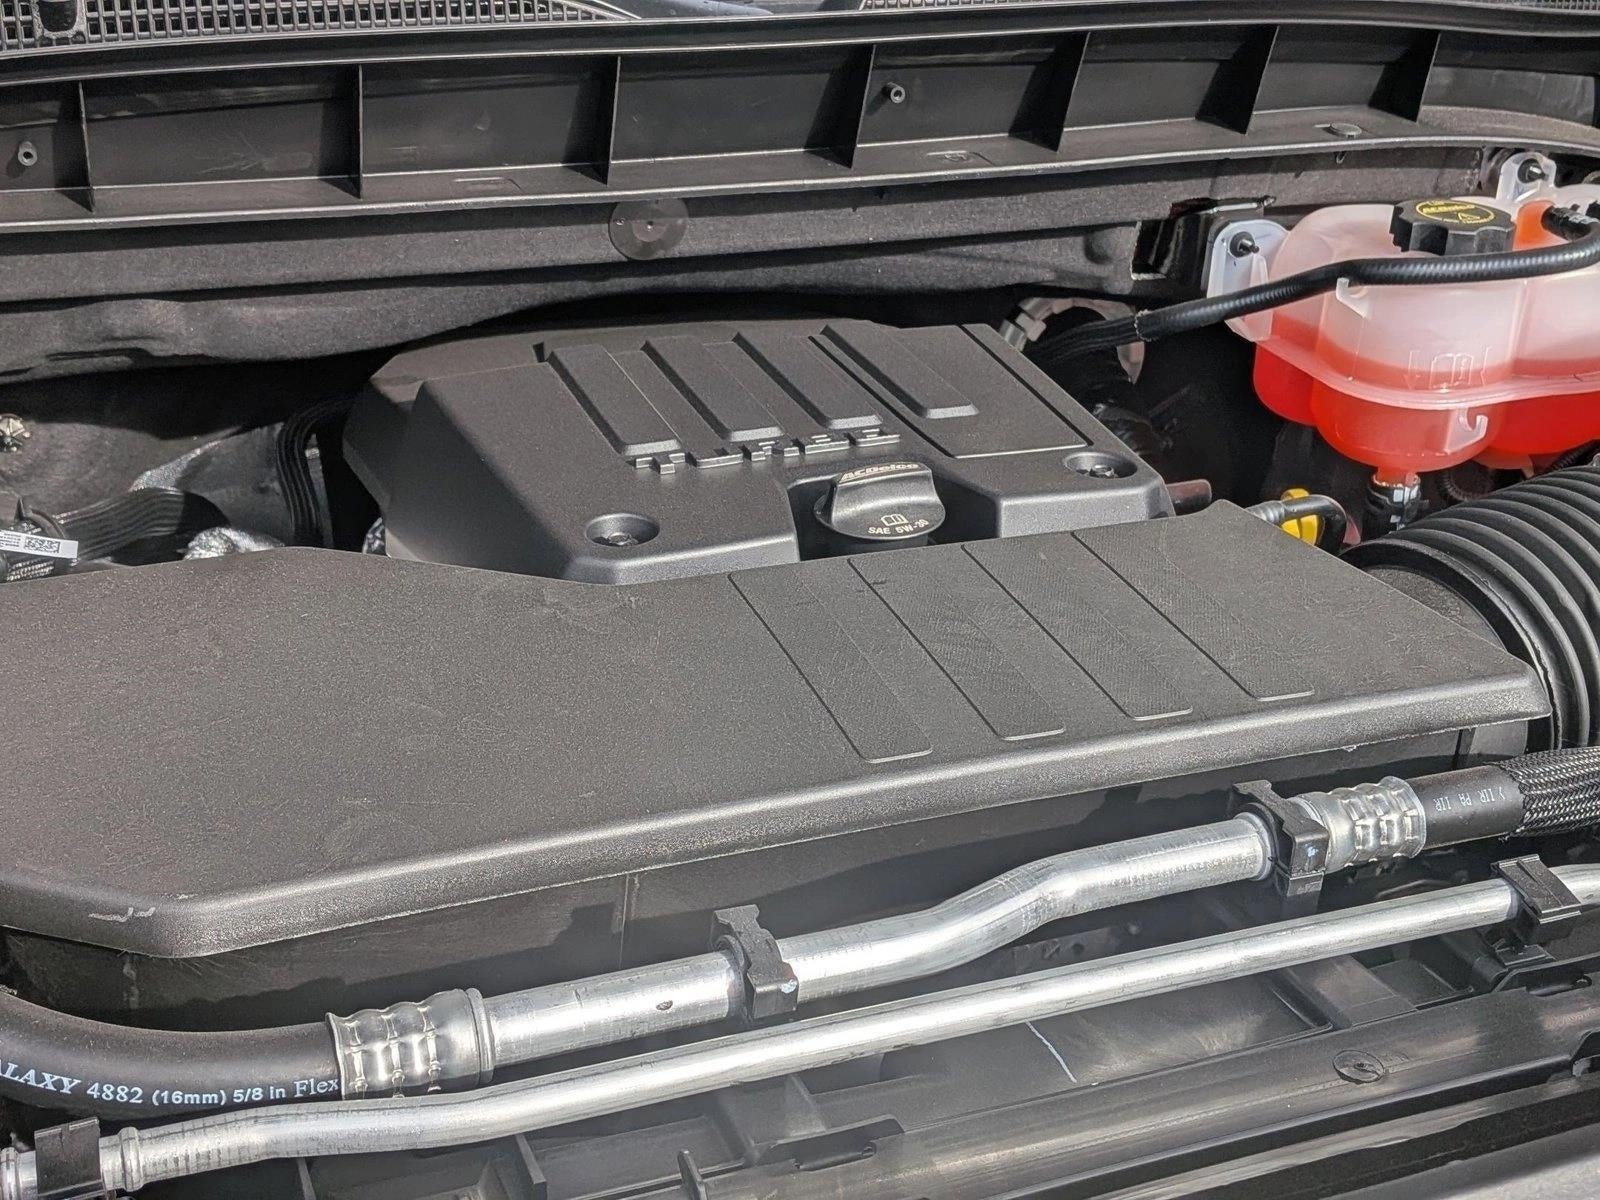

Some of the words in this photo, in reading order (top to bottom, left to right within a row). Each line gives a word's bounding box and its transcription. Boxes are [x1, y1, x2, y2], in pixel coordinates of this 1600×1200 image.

[867, 526, 892, 535] SAE
[0, 1058, 82, 1095] LAXY
[86, 1082, 144, 1104] 4882
[152, 1089, 226, 1106] (16mm)
[232, 1088, 264, 1103] 5/8
[269, 1086, 286, 1100] in
[294, 1078, 339, 1097] Flex
